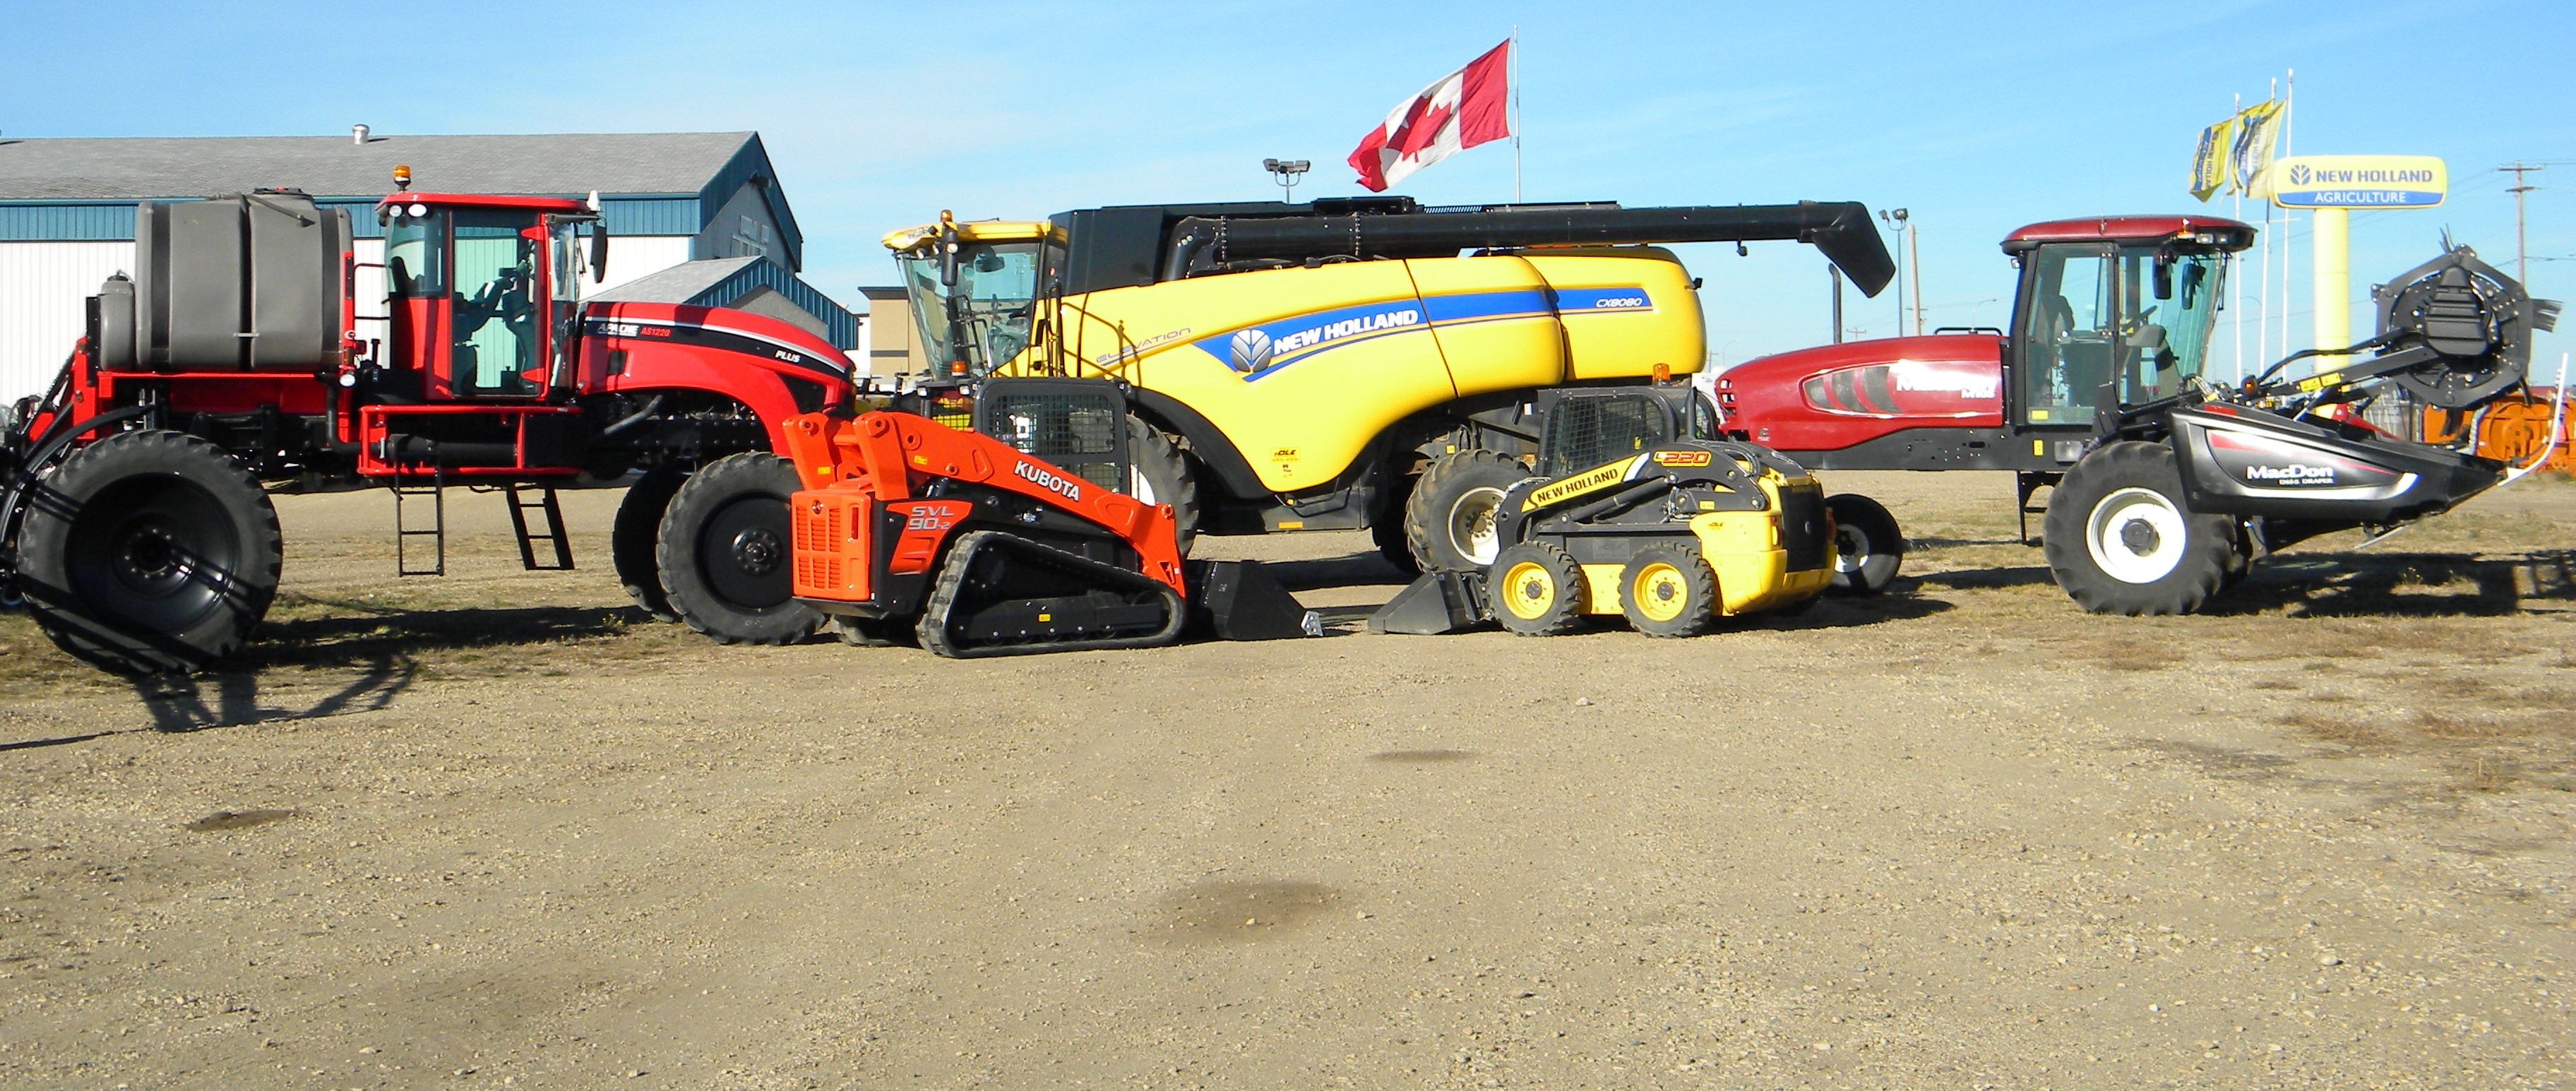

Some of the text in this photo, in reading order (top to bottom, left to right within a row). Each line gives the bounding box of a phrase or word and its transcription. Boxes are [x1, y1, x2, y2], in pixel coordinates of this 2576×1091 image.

[2316, 170, 2433, 182] NEW HOLLAND
[2314, 191, 2406, 203] AGRICULTURE
[1596, 297, 1643, 308] CX8080
[640, 327, 671, 338] AS1220
[1274, 309, 1419, 354] NEW HOLLAND
[775, 350, 801, 363] PLUS
[2246, 464, 2334, 479] MacDon
[1014, 460, 1080, 501] KUBOTA
[1537, 468, 1618, 503] NEW HOLLAND
[910, 506, 954, 517] SVL
[907, 517, 950, 530] 90-2
